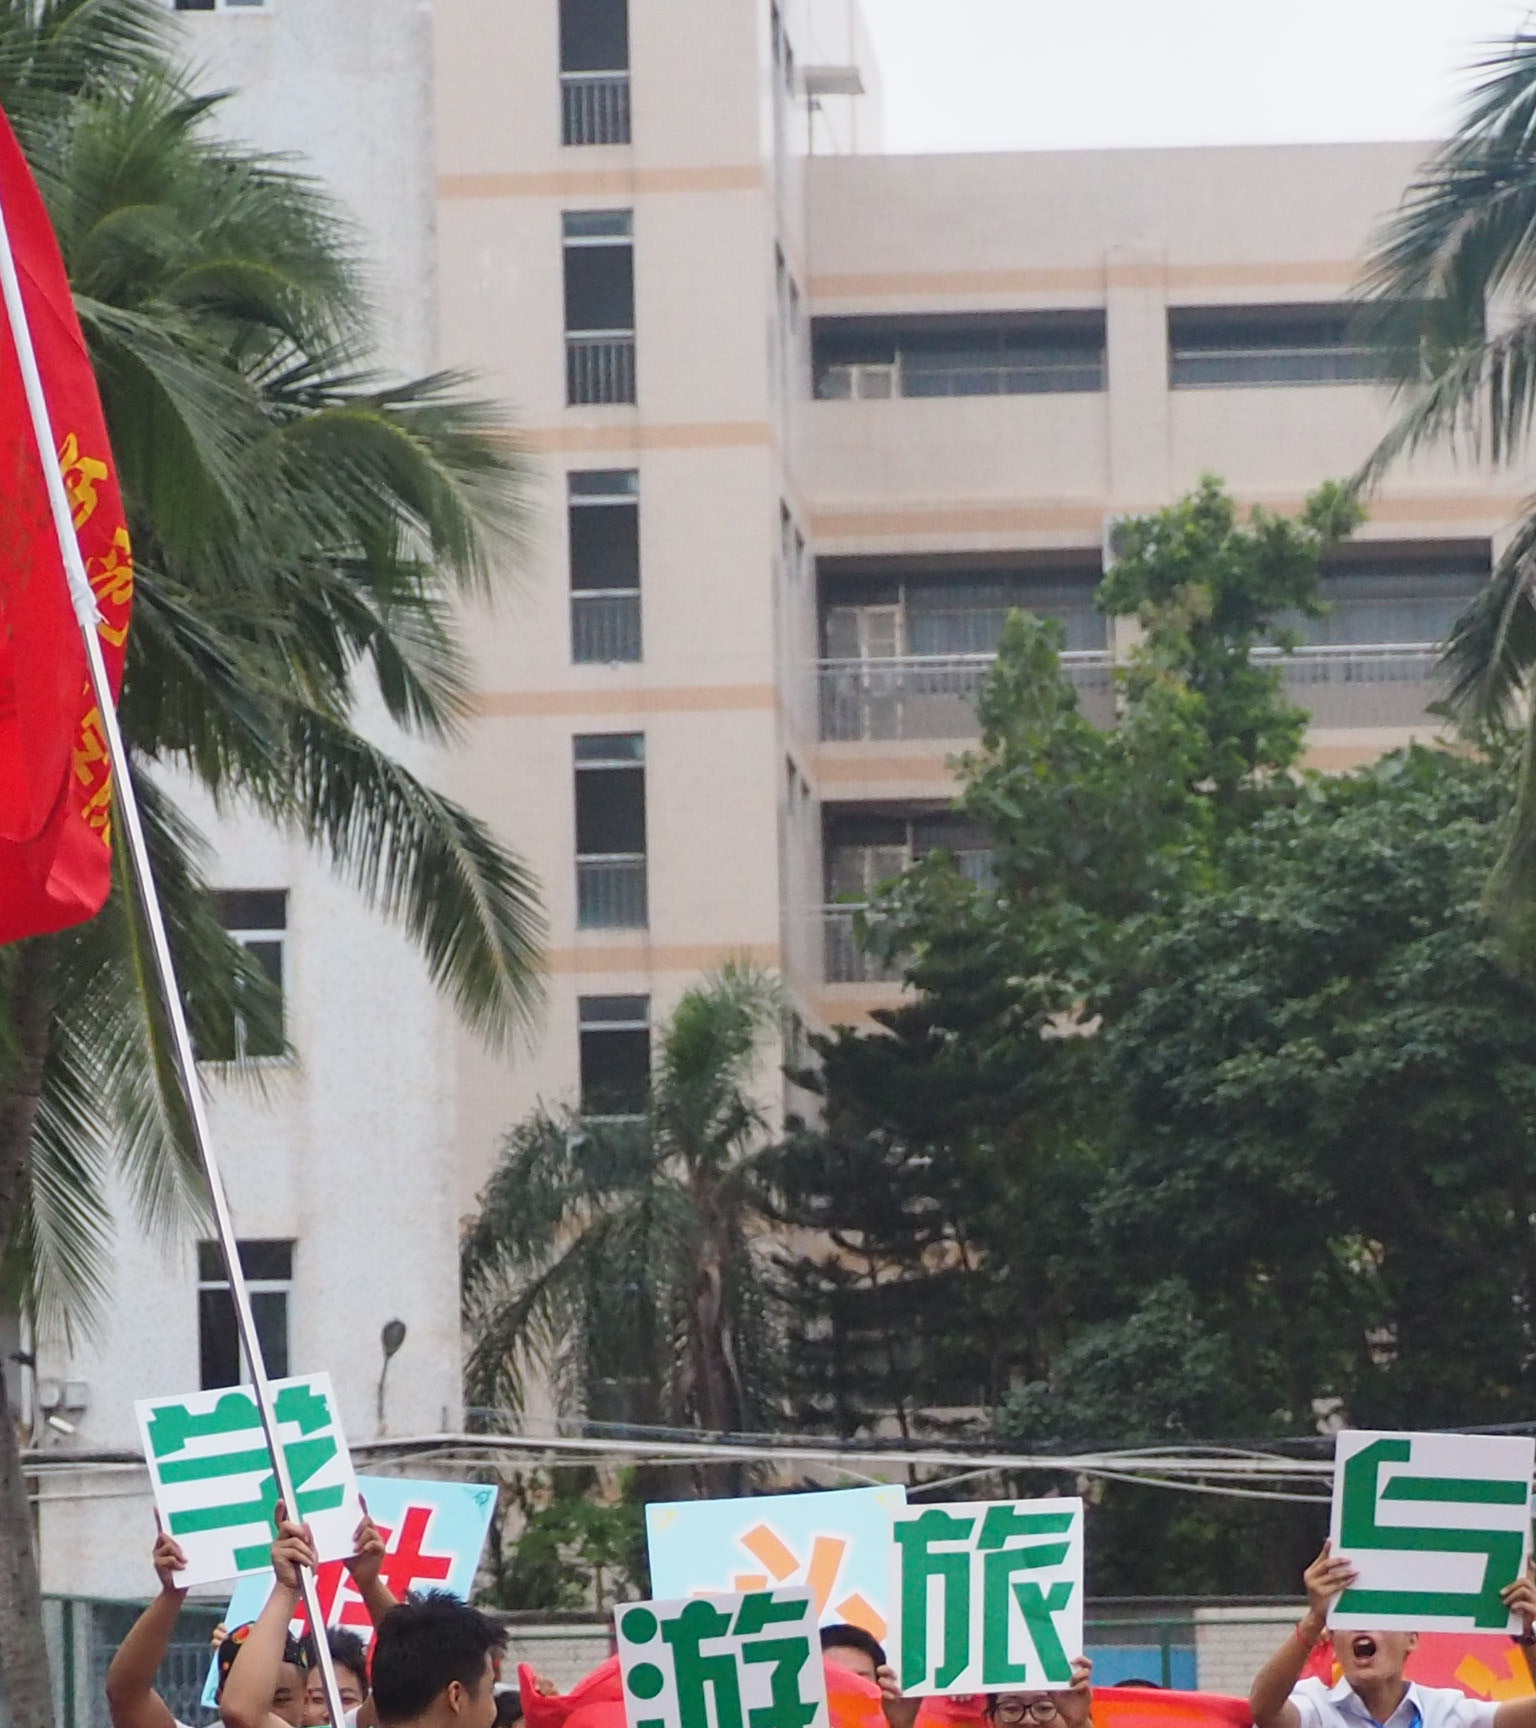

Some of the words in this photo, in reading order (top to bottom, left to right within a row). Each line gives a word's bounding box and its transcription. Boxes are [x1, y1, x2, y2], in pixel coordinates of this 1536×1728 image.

[148, 1385, 344, 1572] 学
[1334, 1439, 1528, 1629] 与
[894, 1505, 1074, 1690] 旅
